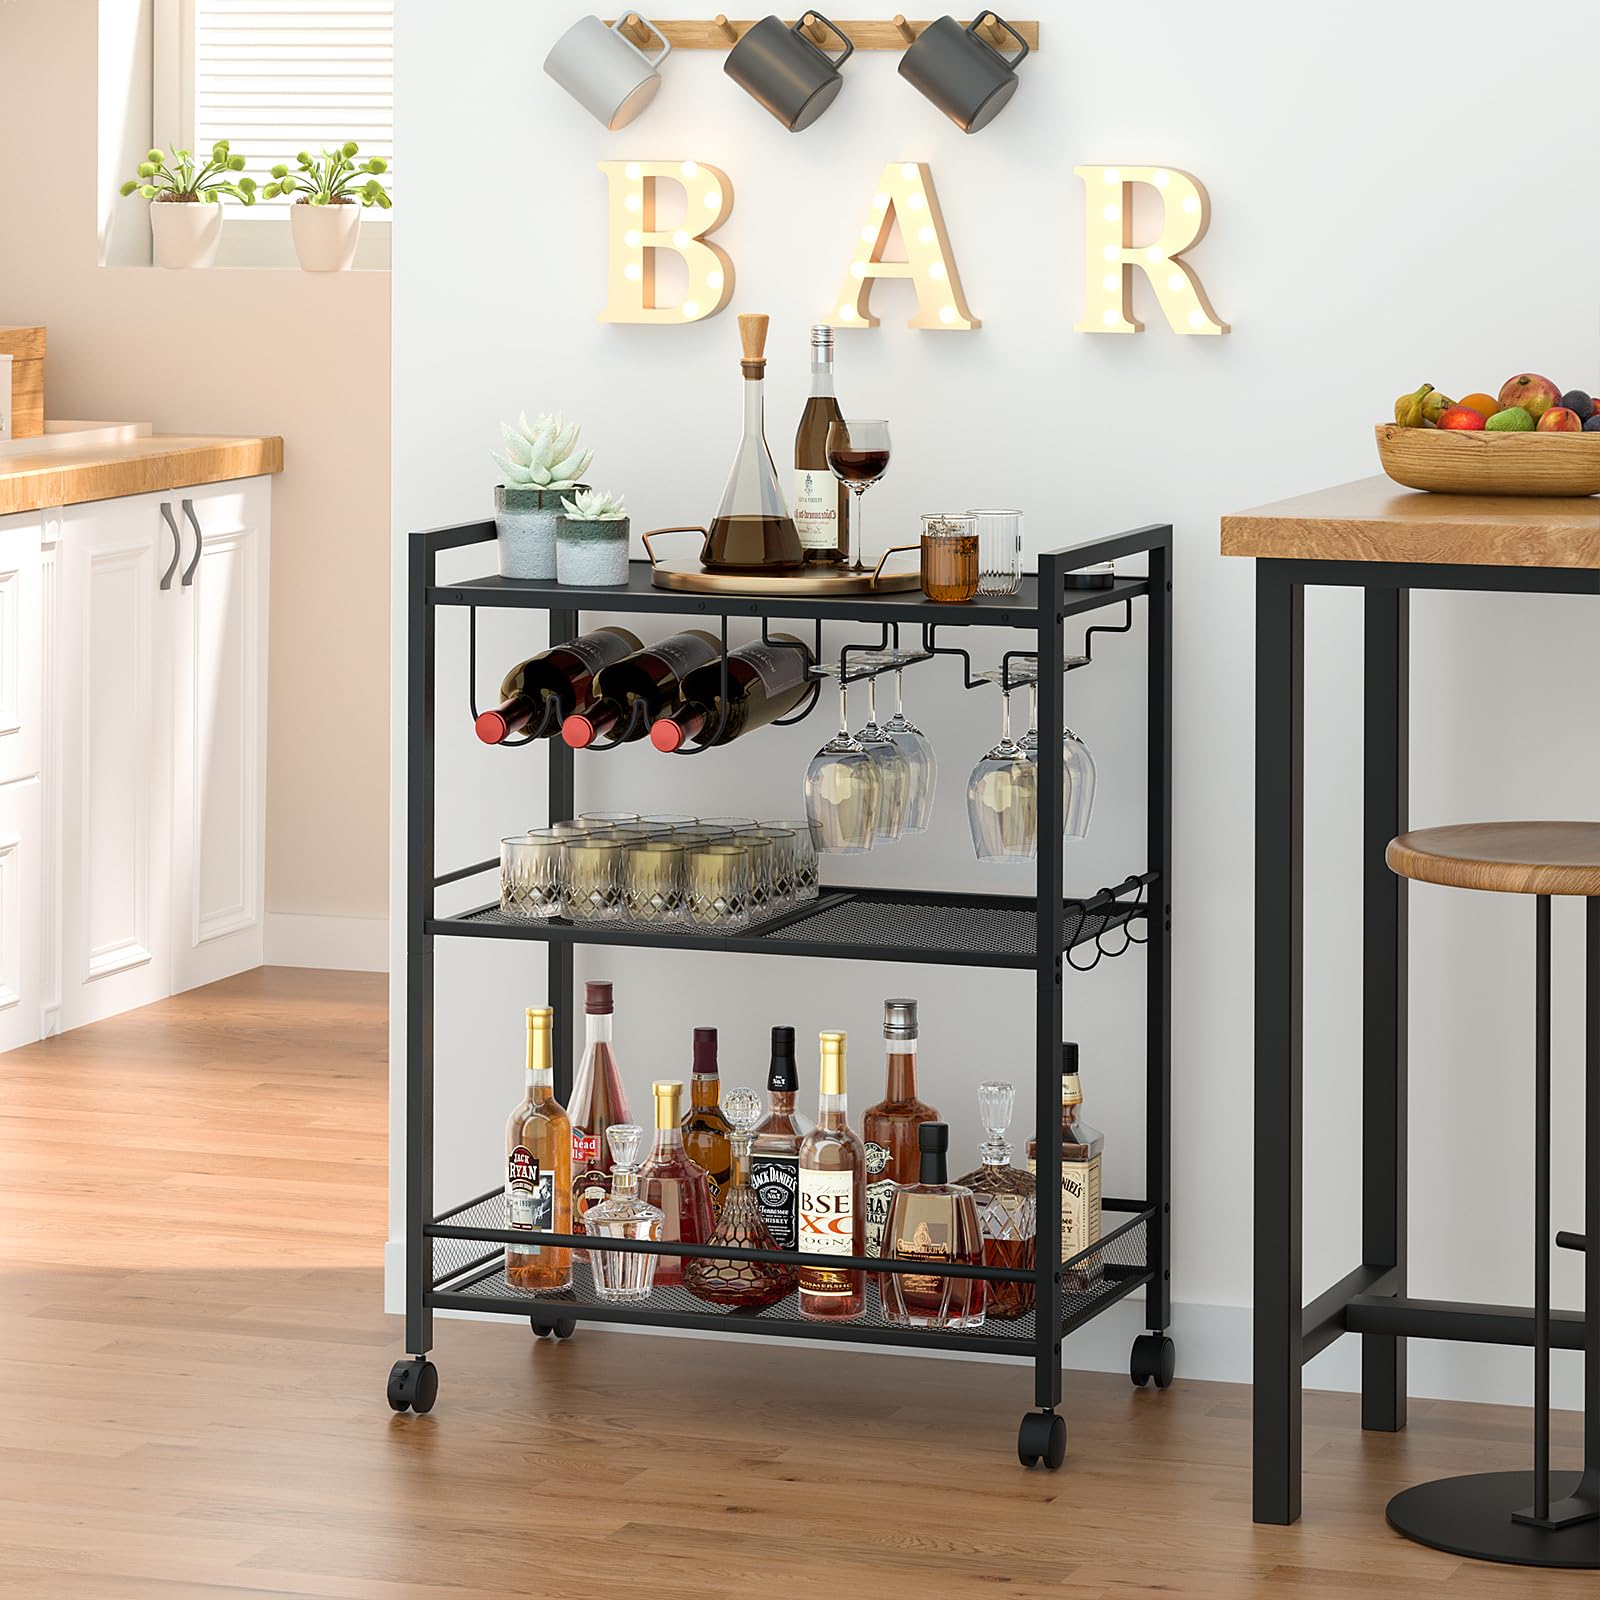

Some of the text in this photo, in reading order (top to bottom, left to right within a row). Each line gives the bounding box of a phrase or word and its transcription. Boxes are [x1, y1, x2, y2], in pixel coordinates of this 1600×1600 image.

[514, 1153, 530, 1164] JACK
[510, 1162, 538, 1181] RYAN
[753, 1166, 798, 1192] JACK DANIEL'S
[801, 1192, 850, 1214] BSE
